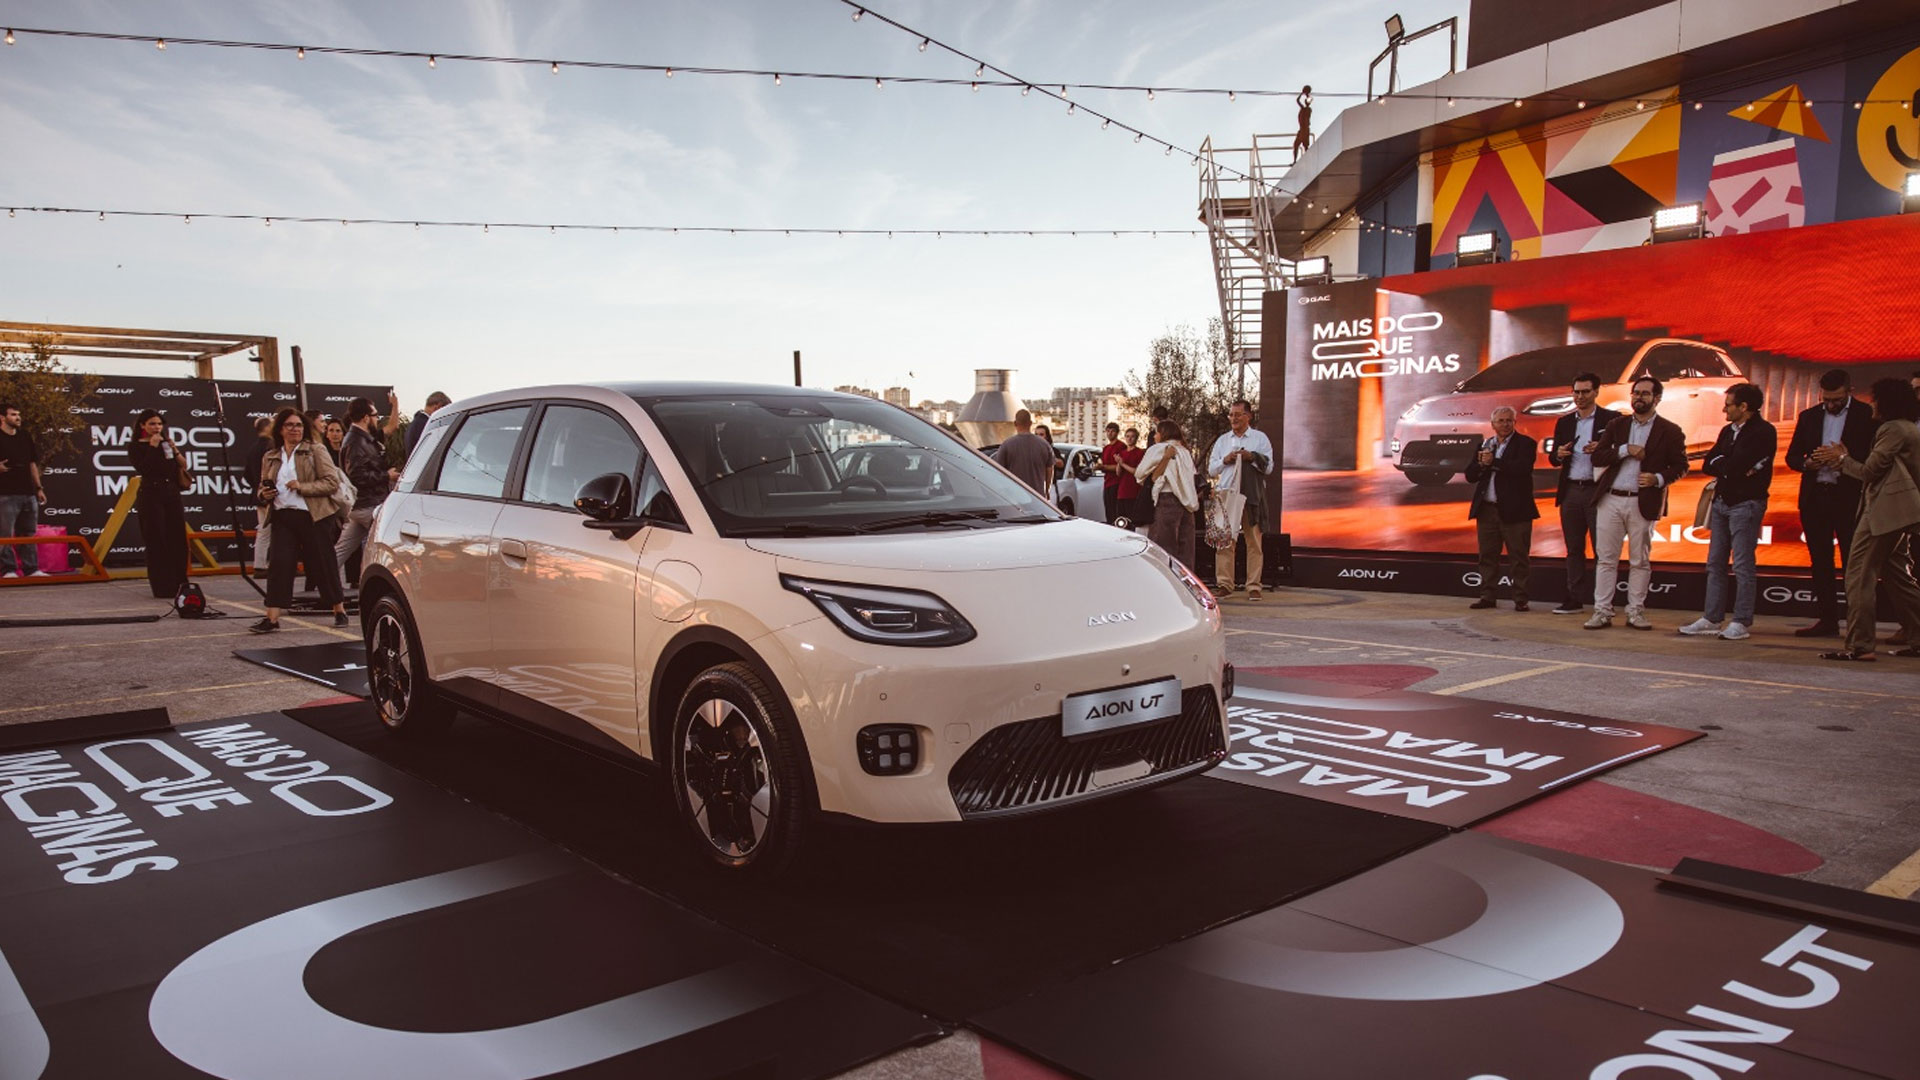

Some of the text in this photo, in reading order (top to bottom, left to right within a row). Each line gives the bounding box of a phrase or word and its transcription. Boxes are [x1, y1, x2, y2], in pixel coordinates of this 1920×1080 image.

[1310, 294, 1331, 302] GAC
[1312, 311, 1443, 340] MAIS DO
[1312, 336, 1413, 360] QUE
[1311, 353, 1460, 381] IMAGINAS
[91, 425, 235, 448] MA DO
[1337, 568, 1399, 580] AION UT
[1648, 582, 1677, 593] UT
[1087, 611, 1137, 627] AION
[1085, 694, 1165, 721] AION UT
[83, 738, 253, 818] QUE
[180, 723, 395, 817] MAIS DO
[1218, 752, 1470, 809] MAIS
[1721, 924, 1875, 1009] UT
